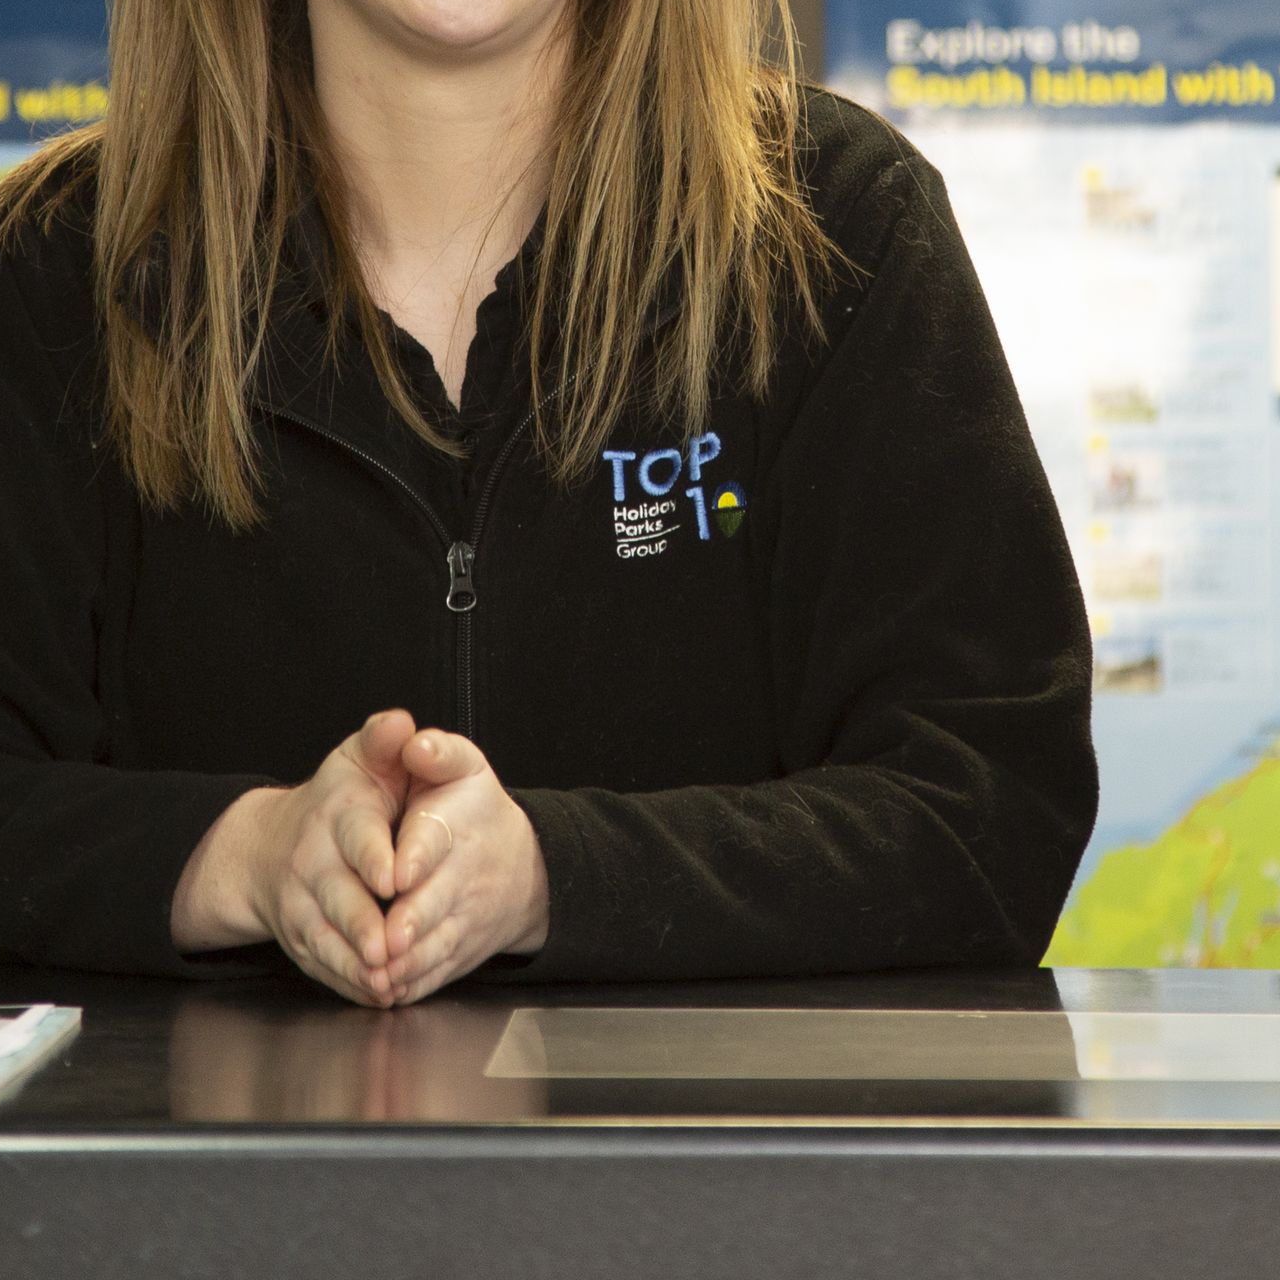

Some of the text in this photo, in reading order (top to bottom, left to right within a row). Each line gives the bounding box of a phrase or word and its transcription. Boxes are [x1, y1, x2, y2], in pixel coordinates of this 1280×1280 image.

[885, 21, 1140, 68] Explore the
[885, 63, 1025, 107] South
[1031, 62, 1168, 106] Island
[1173, 60, 1275, 106] with
[602, 431, 721, 502] TOP
[613, 499, 676, 523] Holiday
[614, 519, 664, 538] Parks
[616, 539, 668, 559] Group
